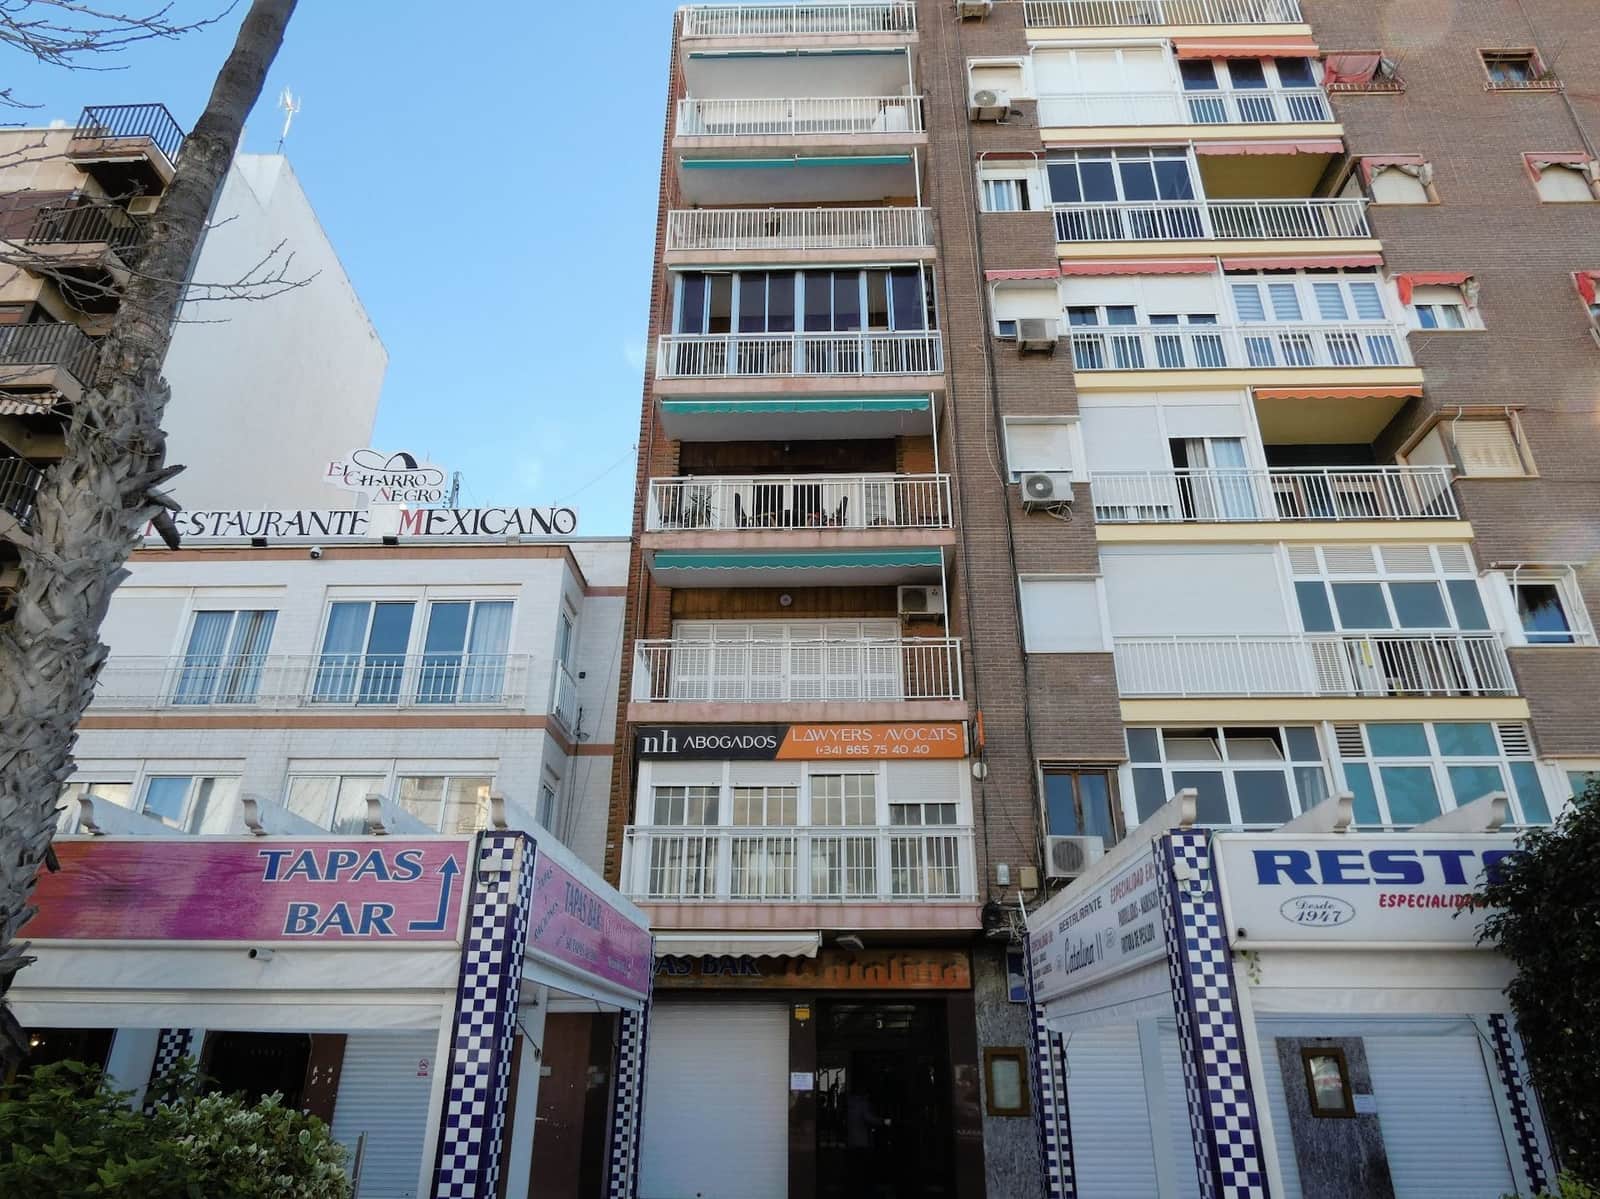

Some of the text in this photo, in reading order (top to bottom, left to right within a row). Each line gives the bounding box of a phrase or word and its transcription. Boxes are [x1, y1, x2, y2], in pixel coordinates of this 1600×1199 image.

[344, 470, 427, 488] CHARRO
[372, 487, 442, 502] NEGRO
[398, 508, 577, 535] MEXICANO
[641, 729, 777, 753] nh ABOGADOS
[792, 727, 958, 742] LAWYERS AVOCATS
[815, 744, 930, 755] (+34) 865 75 40 40
[258, 849, 425, 882] TAPAS
[1295, 899, 1335, 911] Desde
[281, 901, 398, 936] BAR
[1296, 910, 1342, 923] 1947
